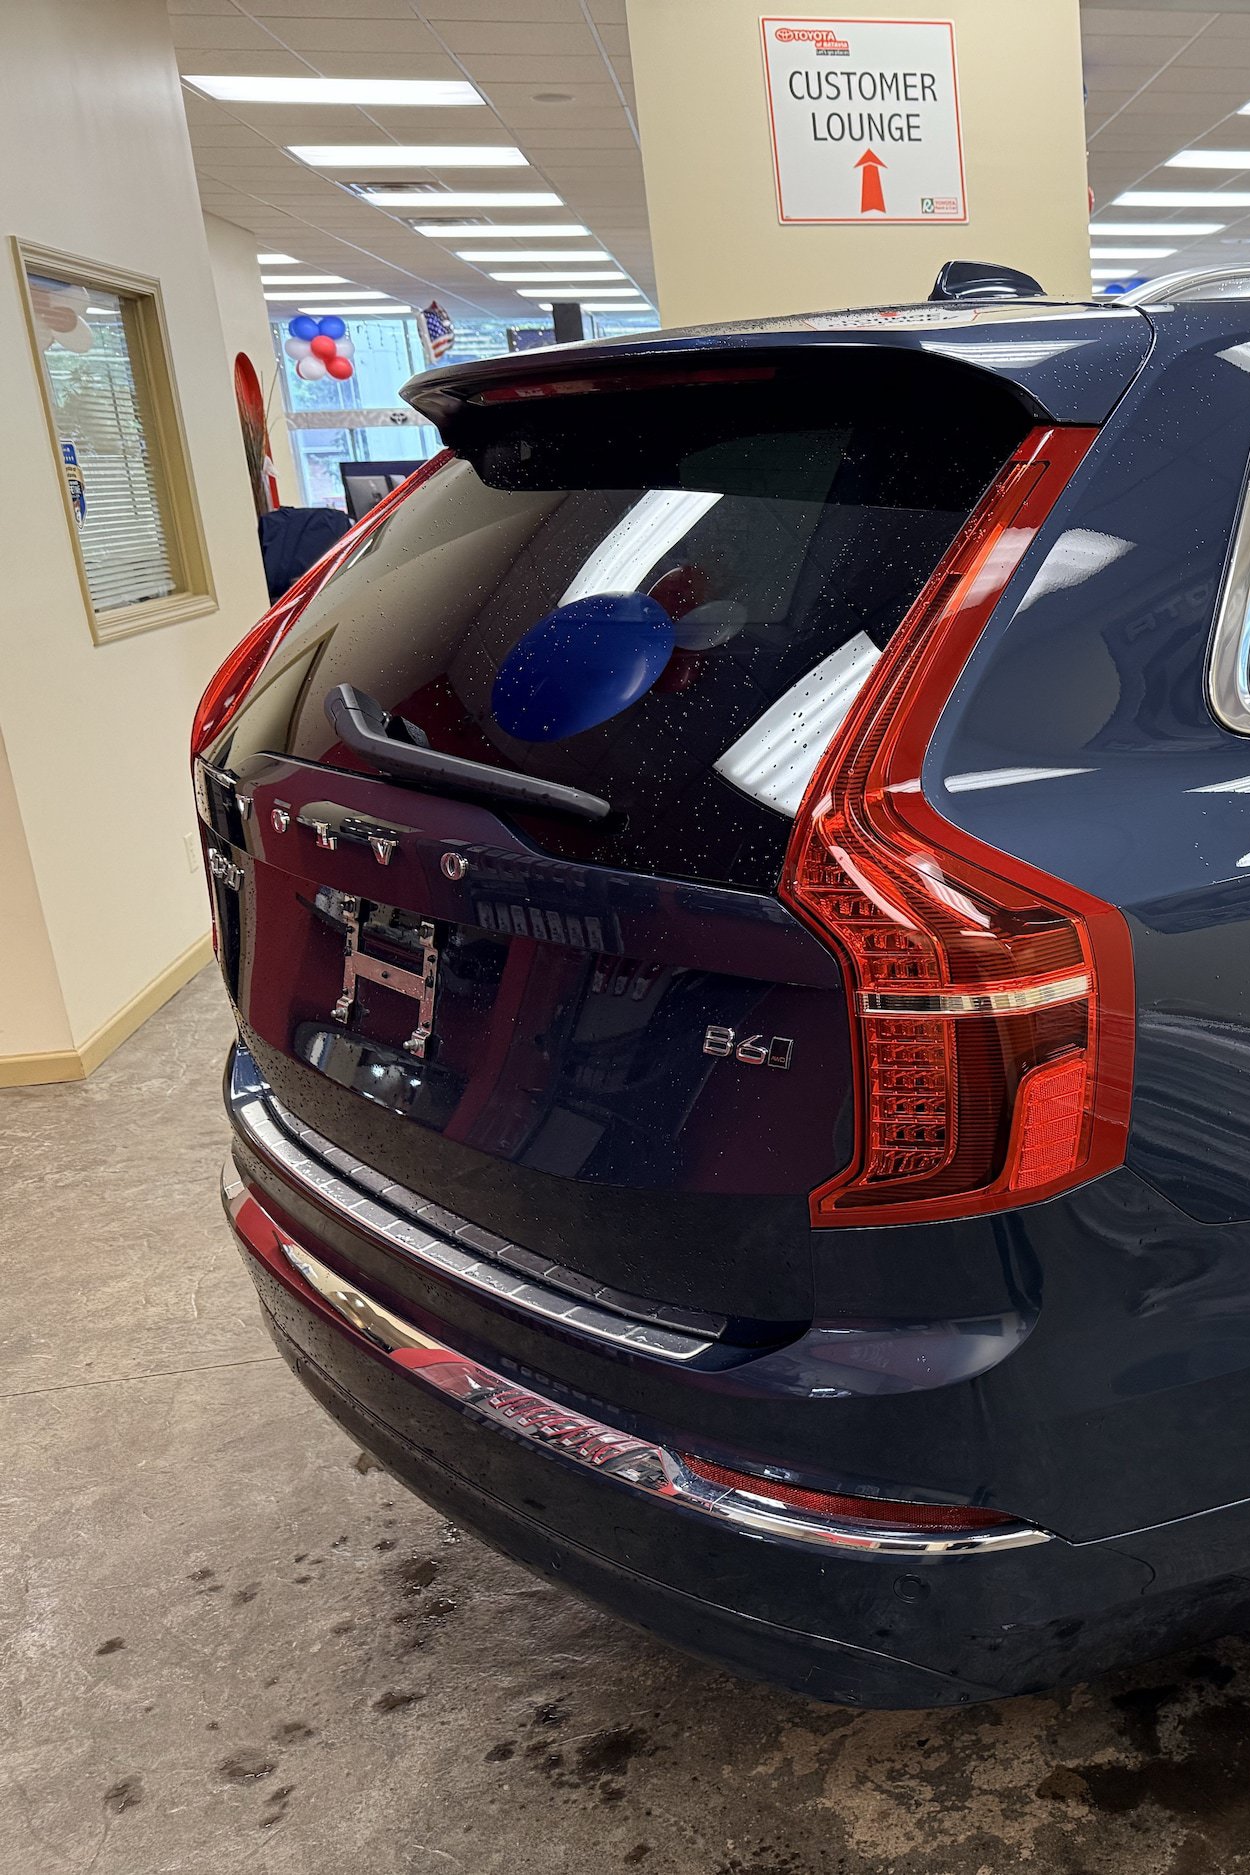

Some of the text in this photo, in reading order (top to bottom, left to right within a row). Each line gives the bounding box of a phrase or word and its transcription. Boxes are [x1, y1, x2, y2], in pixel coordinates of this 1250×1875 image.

[793, 31, 835, 41] TOYOTA
[789, 70, 938, 102] CUSTOMER
[812, 112, 922, 142] LOUNGE
[235, 793, 468, 881] VOLVO
[703, 1025, 768, 1065] B6
